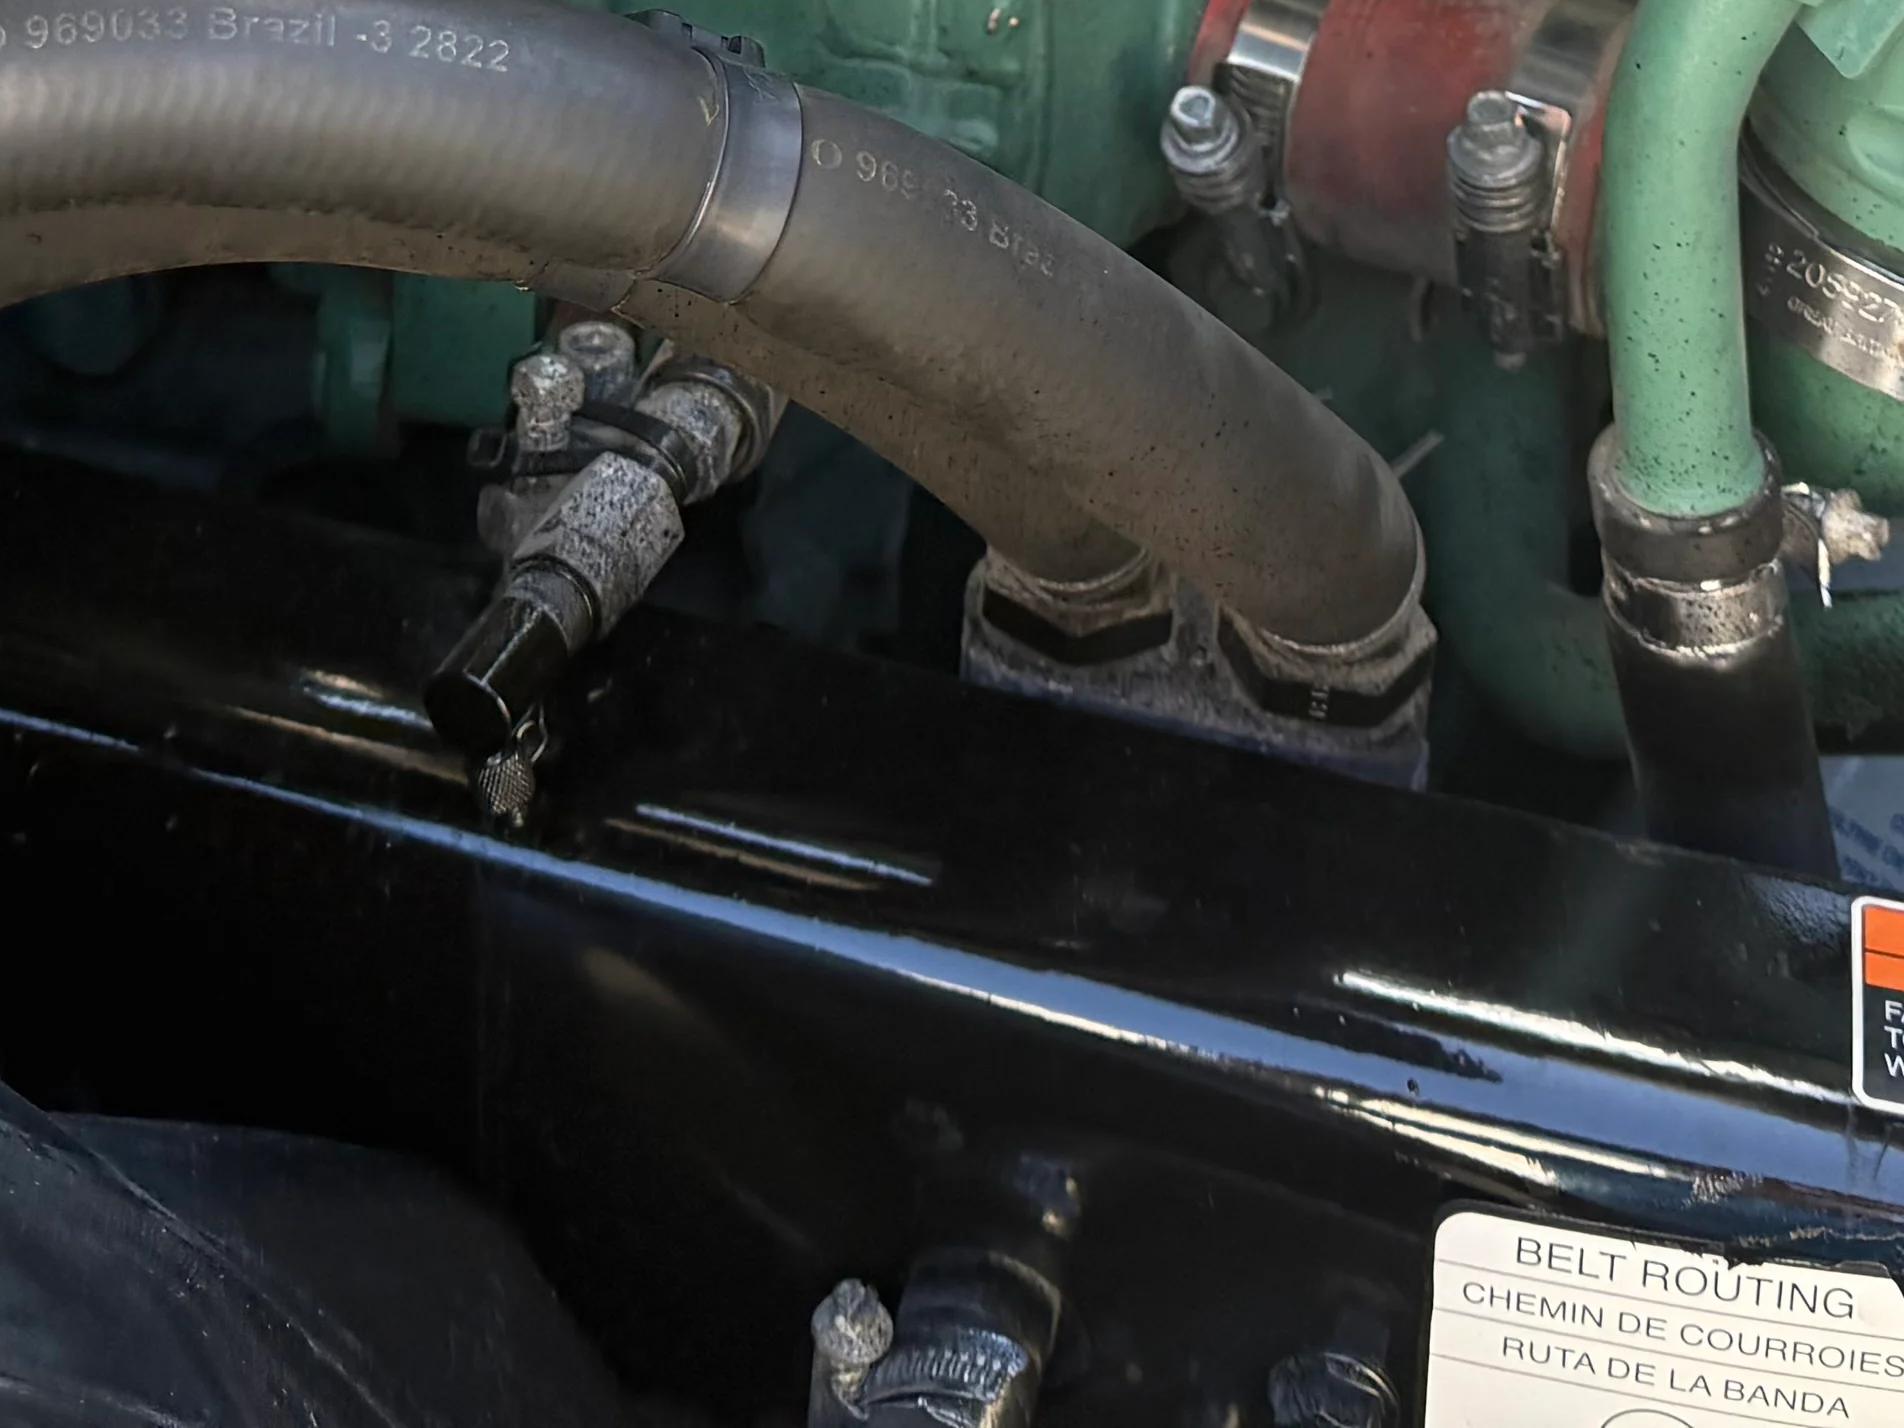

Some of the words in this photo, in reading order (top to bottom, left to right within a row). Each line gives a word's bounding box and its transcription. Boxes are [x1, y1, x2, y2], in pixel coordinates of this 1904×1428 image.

[25, 7, 188, 50] 969033
[207, 7, 336, 46] Brazil
[408, 24, 510, 73] 2822
[1461, 1280, 1604, 1329] CHEMIN
[1617, 1312, 1668, 1342] DE
[1514, 1235, 1628, 1283] BELT
[1640, 1259, 1856, 1320] ROUTING
[1501, 1335, 1598, 1376] RUTA
[1606, 1356, 1657, 1386] DE
[1668, 1369, 1713, 1398] LA
[1723, 1379, 1851, 1419] BANDA
